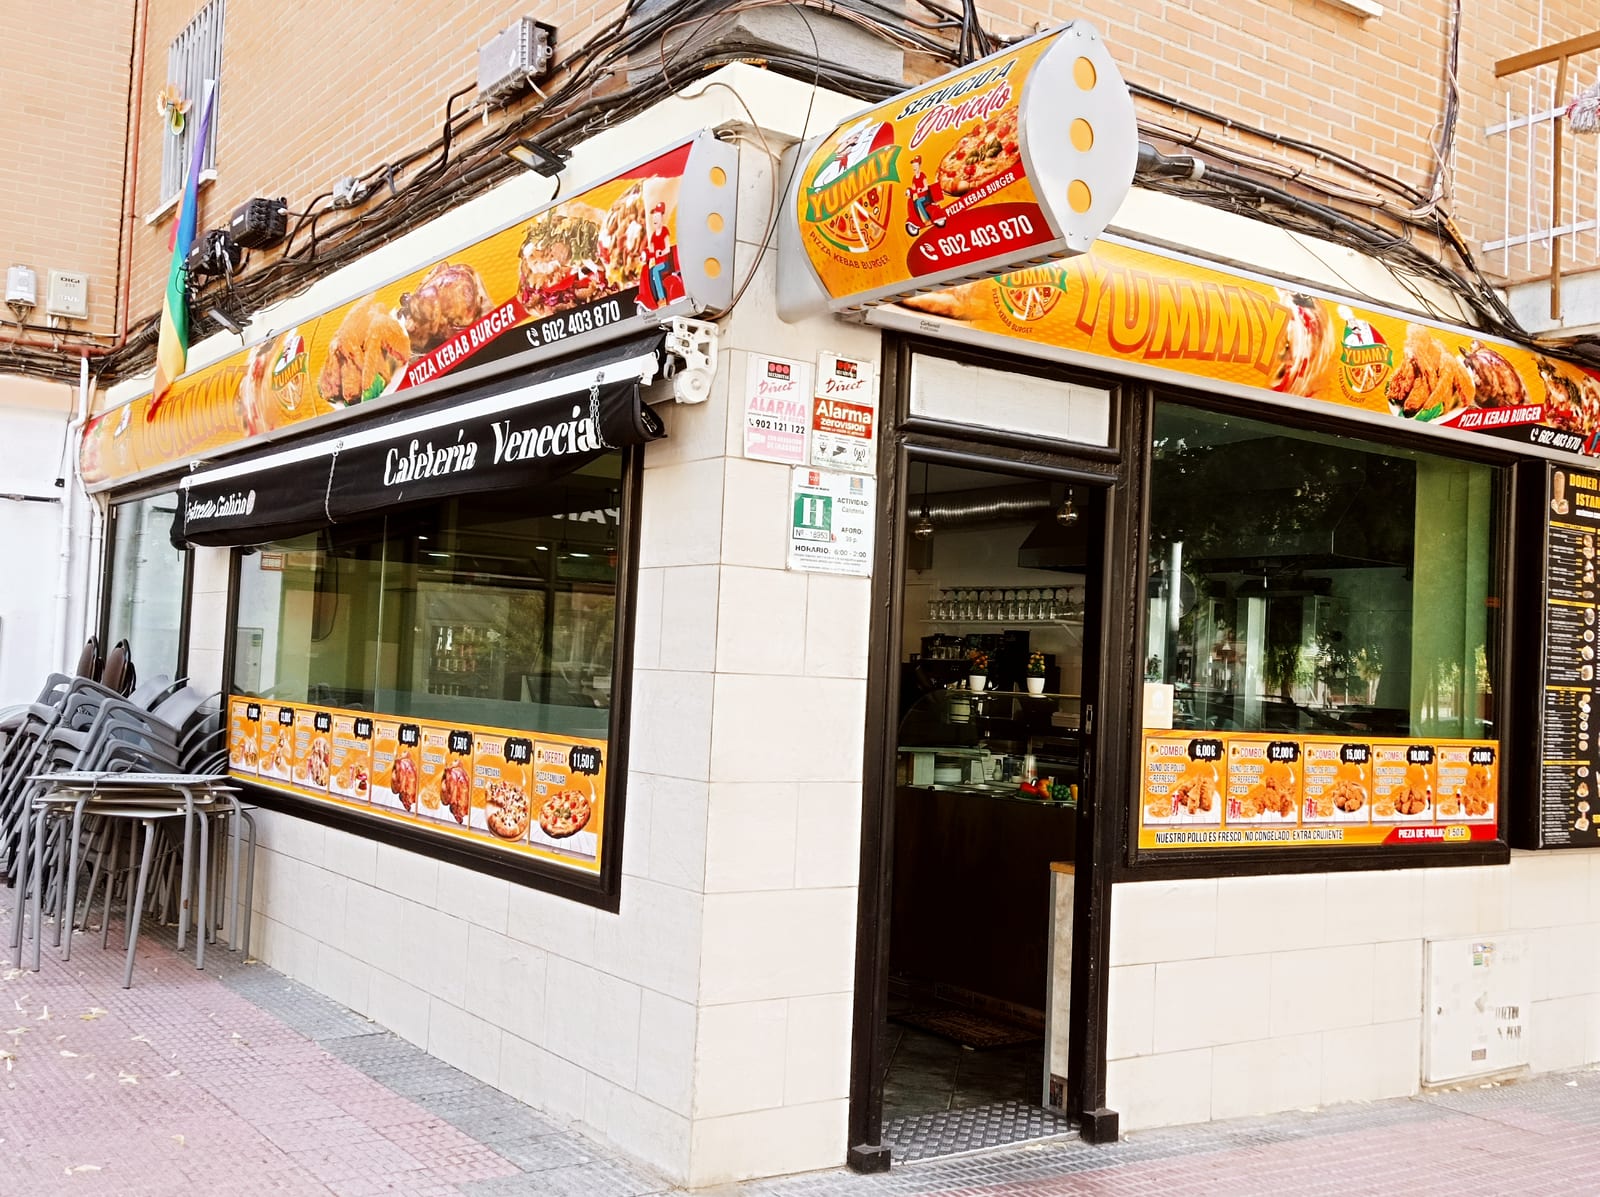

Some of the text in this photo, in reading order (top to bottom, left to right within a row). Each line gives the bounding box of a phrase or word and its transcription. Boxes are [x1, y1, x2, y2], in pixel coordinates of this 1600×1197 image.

[897, 59, 1016, 120] SERVICIO A
[911, 81, 1011, 149] Domicilio
[809, 150, 896, 221] YUMMY
[945, 172, 1016, 217] PIZZA KEBAB BURGER
[938, 214, 1034, 257] 602 403 870
[809, 231, 892, 271] PIZZA KEBAB BURGER
[541, 300, 621, 343] 602 403 870
[1075, 257, 1293, 376] YUMMY
[408, 304, 517, 387] PIZZA KEBAB BURGER
[1343, 348, 1390, 364] YUMMY
[273, 354, 307, 390] YUMMY
[825, 378, 868, 394] Direct
[749, 397, 806, 418] ALARMA
[815, 400, 872, 425] Alarma
[1457, 406, 1542, 428] PIZZA KEBAB BURGER
[755, 418, 771, 430] 902
[774, 421, 787, 432] 121
[791, 424, 805, 434] 122
[820, 417, 869, 433] zerovision
[383, 405, 602, 487] Cafetería Venecia
[1538, 430, 1582, 451] 602 403 870
[1569, 474, 1598, 491] DONER
[801, 497, 826, 528] H
[543, 751, 566, 764] OFERTA
[573, 752, 595, 769] 11,50€
[1160, 745, 1184, 756] COMBO
[1196, 745, 1216, 757] 6,00€
[1241, 748, 1263, 758] COMBO
[1272, 746, 1294, 760] 12,00€
[1155, 832, 1186, 844] NUESTRO
[1187, 832, 1208, 843] POLLO
[1208, 832, 1217, 842] ES
[1244, 831, 1254, 842] NO
[1292, 830, 1312, 841] EXTRA
[1312, 829, 1343, 841] CRUJIENTE
[1398, 829, 1416, 839] PIEZA
[1416, 829, 1425, 838] DE
